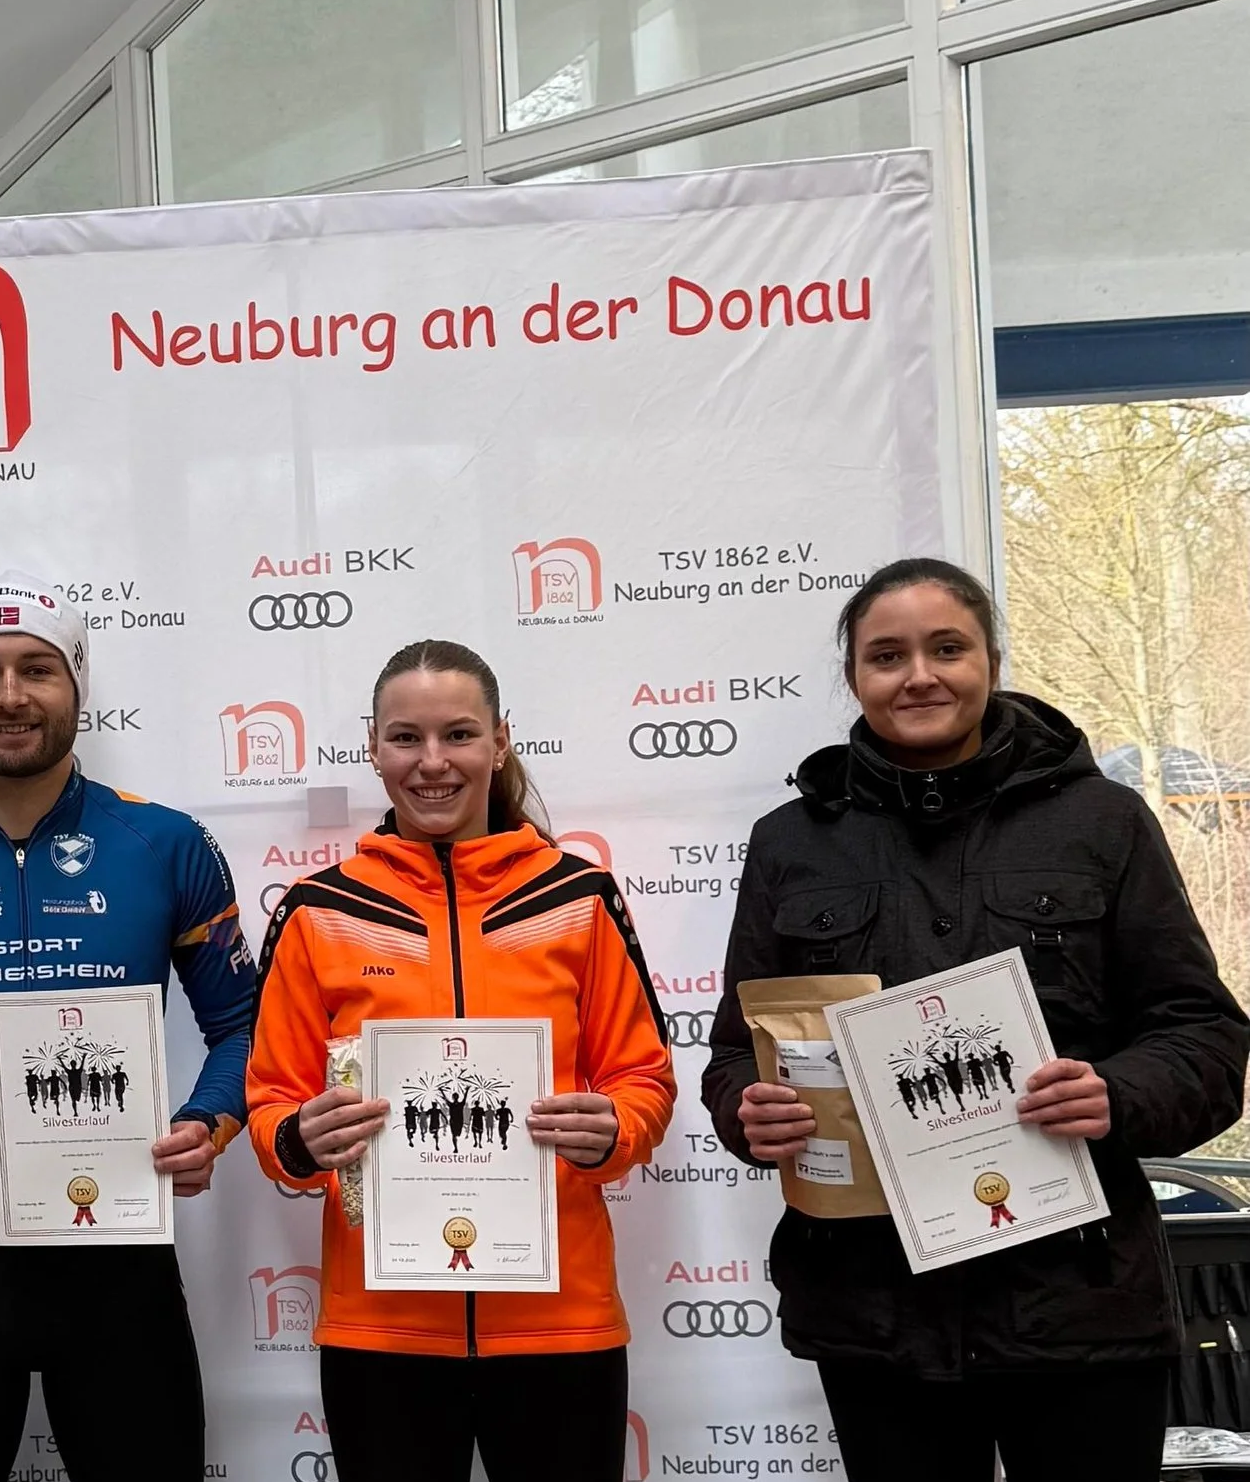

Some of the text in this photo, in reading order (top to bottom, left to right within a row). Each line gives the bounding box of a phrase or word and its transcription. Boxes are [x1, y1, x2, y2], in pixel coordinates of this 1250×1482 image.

[112, 275, 872, 373] Neuburg an der Donau
[250, 547, 415, 579] Audi BKK
[658, 542, 819, 571] TSV 1862 e.V.
[541, 572, 577, 588] TSV
[614, 571, 867, 604] Neuburg an der Donau
[101, 581, 140, 603] e.V.
[545, 590, 574, 604] 1862
[121, 609, 185, 629] Donau
[572, 613, 604, 624] DONAU
[631, 674, 802, 707] Audi BKK
[247, 734, 282, 749] TSV
[252, 753, 280, 766] 1862
[317, 738, 563, 767] Neub onau
[262, 843, 341, 868] Audi
[669, 843, 719, 865] TSV
[626, 874, 721, 898] Neuburg
[361, 965, 396, 976] JAKO
[42, 1114, 111, 1128] Silvesterlauf
[926, 1100, 1003, 1132] Silvesterlauf
[684, 1134, 721, 1153] TS
[419, 1151, 493, 1164] Silvesterlauf
[641, 1162, 738, 1187] Neuburg
[74, 1187, 92, 1197] TSV
[981, 1183, 1002, 1196] TSV
[451, 1229, 469, 1239] TSV
[665, 1259, 749, 1284] Audi
[277, 1299, 311, 1314] TSV
[281, 1319, 310, 1331] 1862
[29, 1435, 59, 1454] TS
[706, 1424, 818, 1446] TSV 1862
[661, 1452, 841, 1480] Neuburg an der
